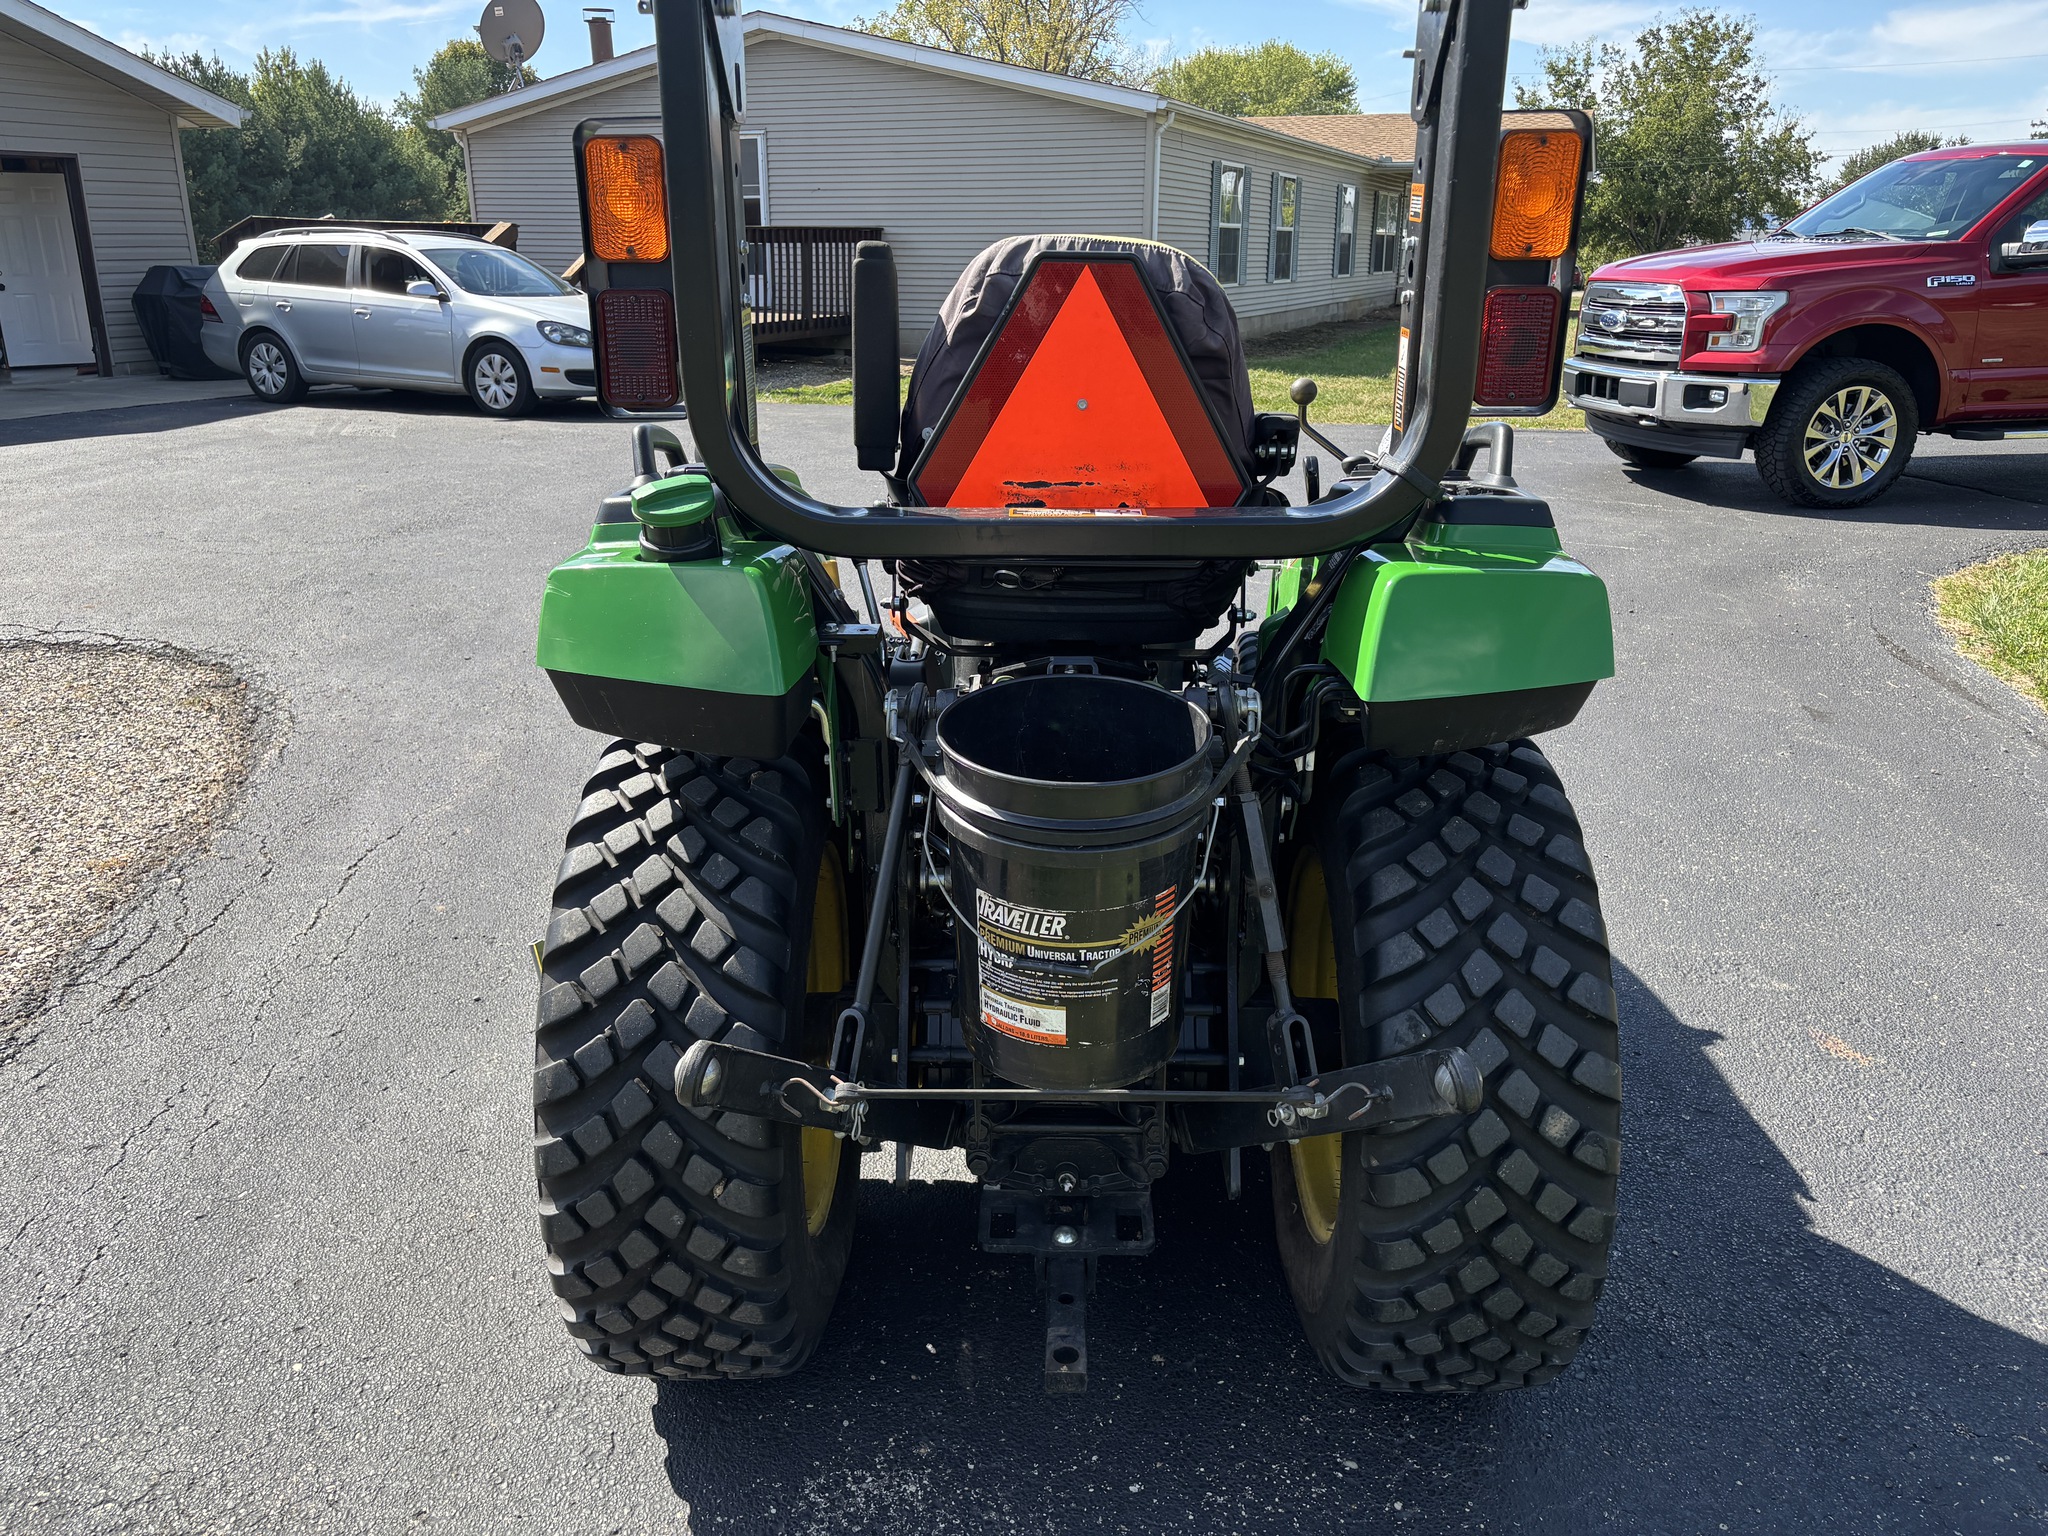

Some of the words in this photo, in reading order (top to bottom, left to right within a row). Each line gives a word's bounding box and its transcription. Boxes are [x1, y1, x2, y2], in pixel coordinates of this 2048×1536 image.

[978, 894, 1066, 937] TRAVELLER
[979, 927, 1026, 956] PREMIUM
[1027, 945, 1077, 962] UNIVERSAL
[984, 999, 1018, 1022] HYDRAULIC
[1020, 1015, 1041, 1028] FLUID
[1004, 1001, 1024, 1014] TRACTOR
